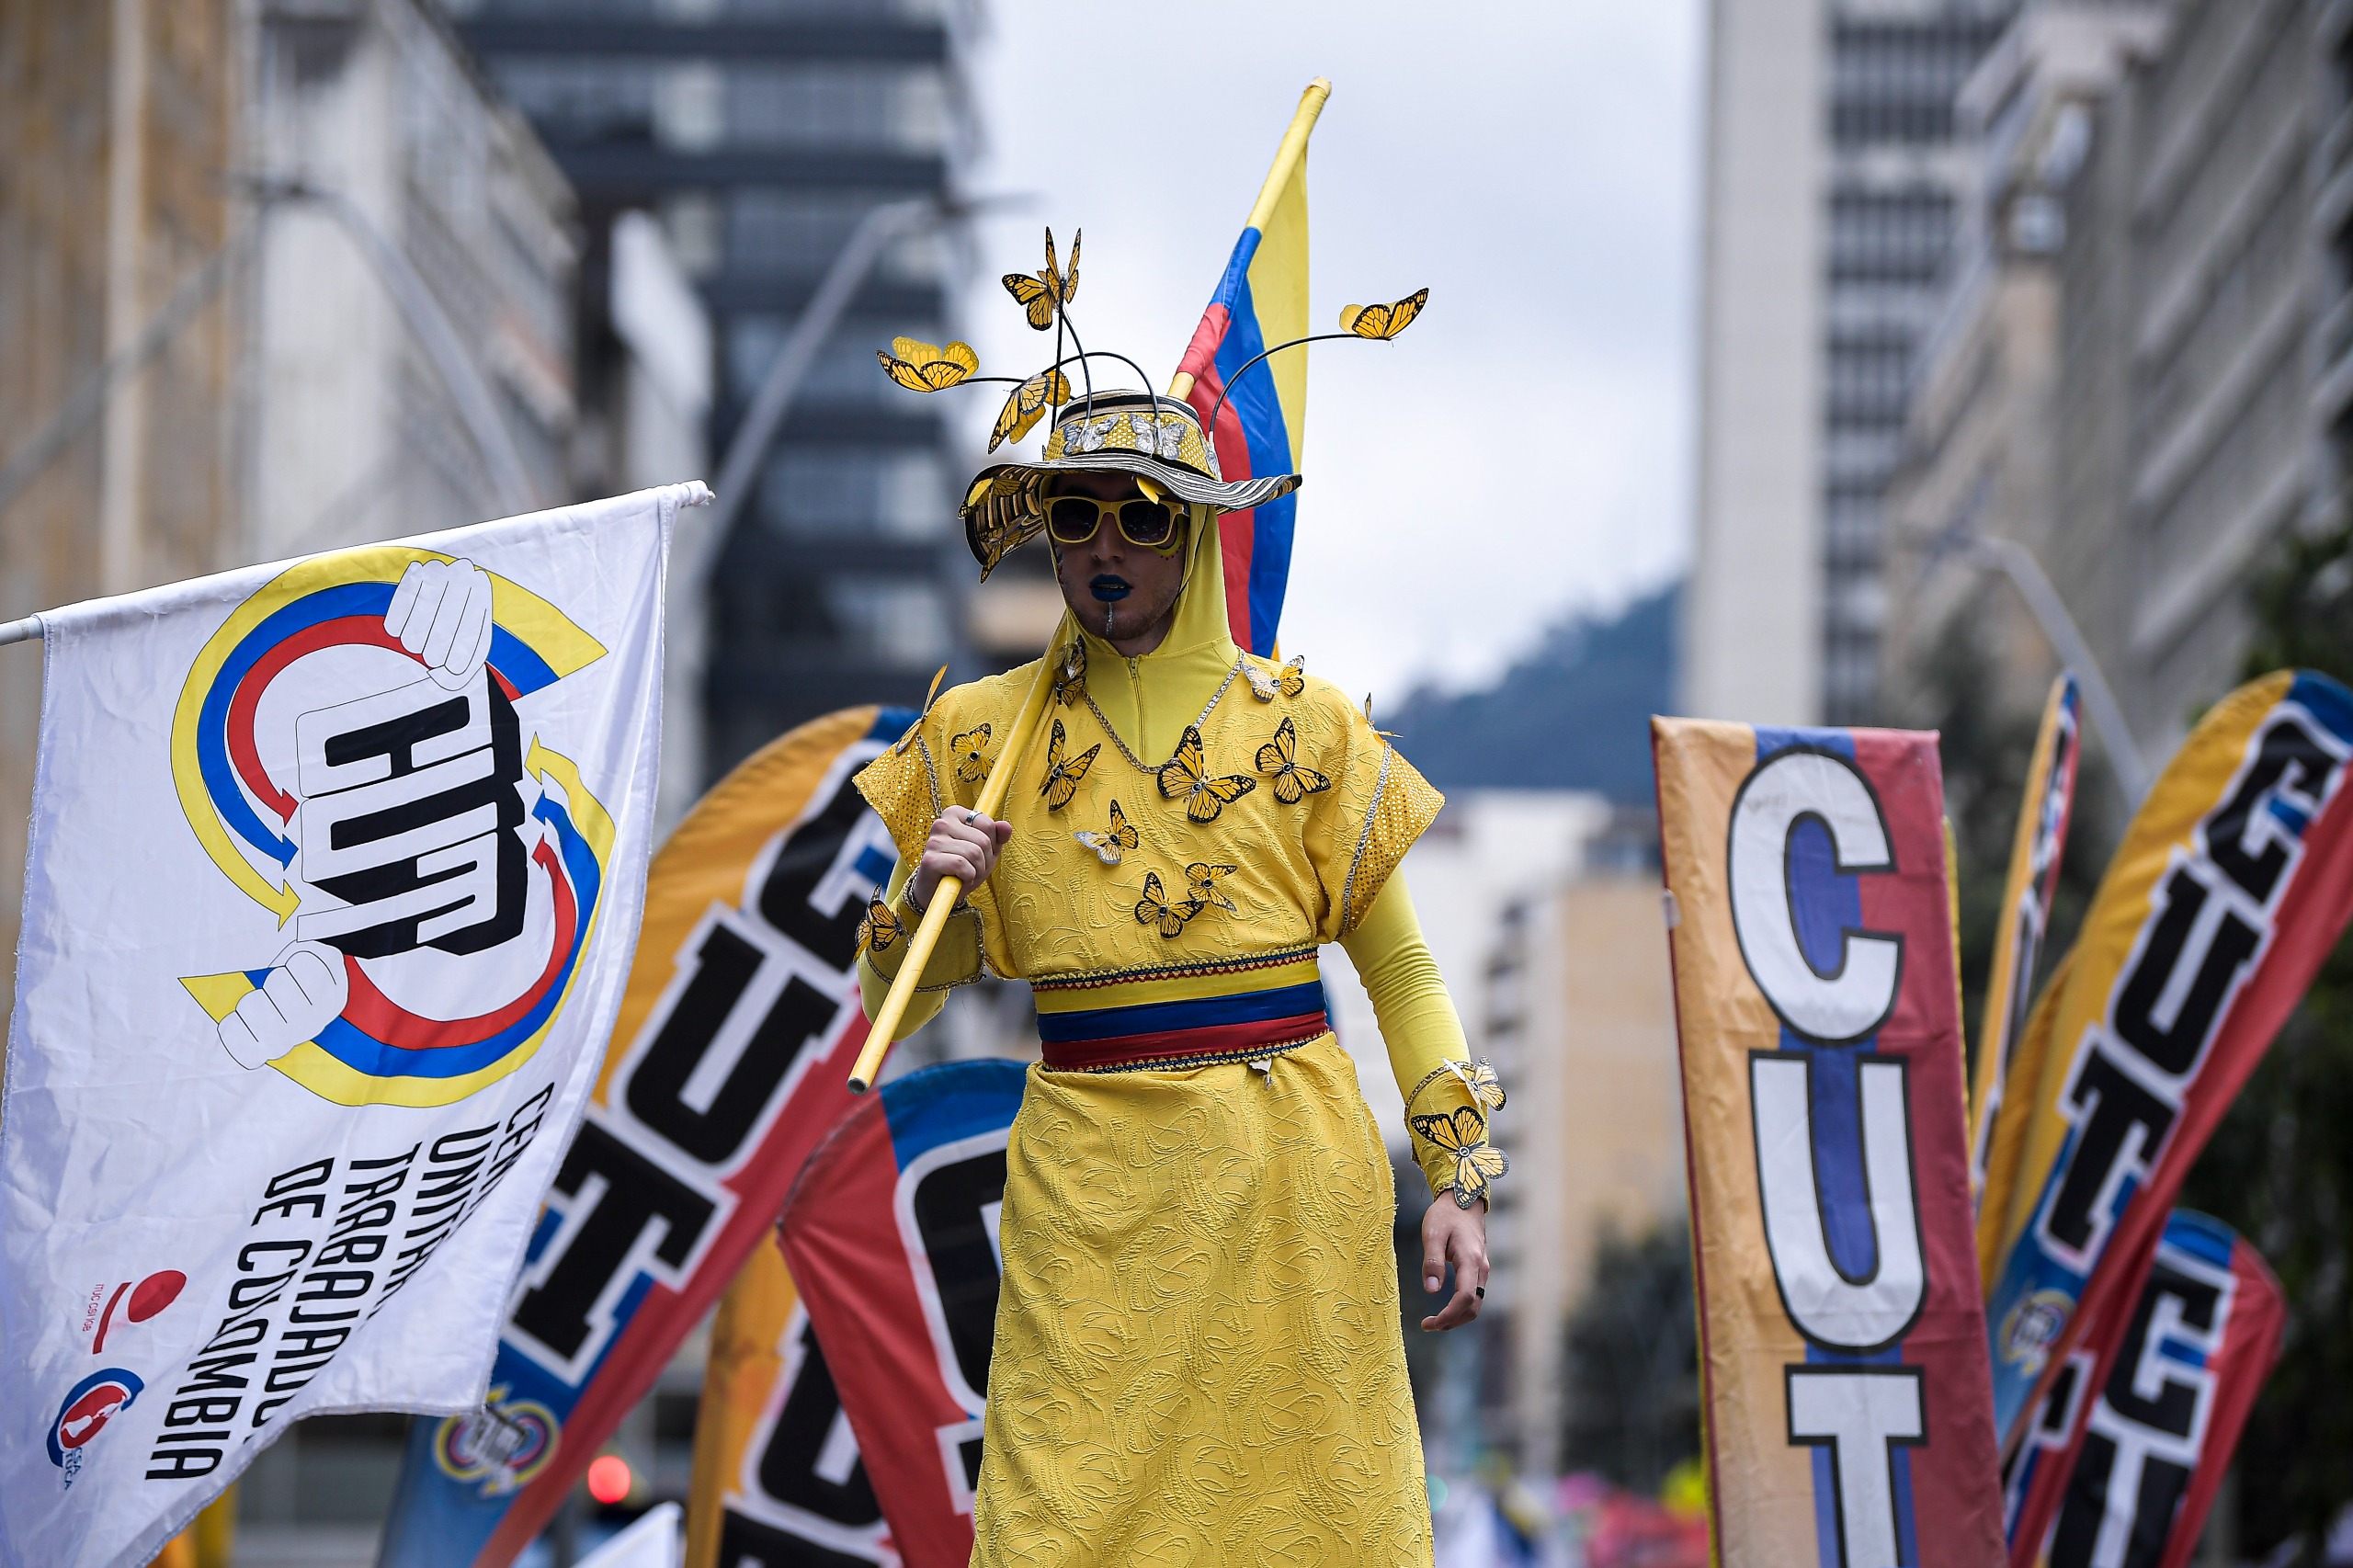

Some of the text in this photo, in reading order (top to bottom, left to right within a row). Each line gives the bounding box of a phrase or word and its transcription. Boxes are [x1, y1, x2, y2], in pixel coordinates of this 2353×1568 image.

[296, 664, 527, 959] CUT
[511, 761, 871, 1365] CUT
[2045, 720, 2340, 1254] CUT
[145, 1157, 335, 1480] DE COLOMBIA
[1727, 744, 1928, 1568] CUT
